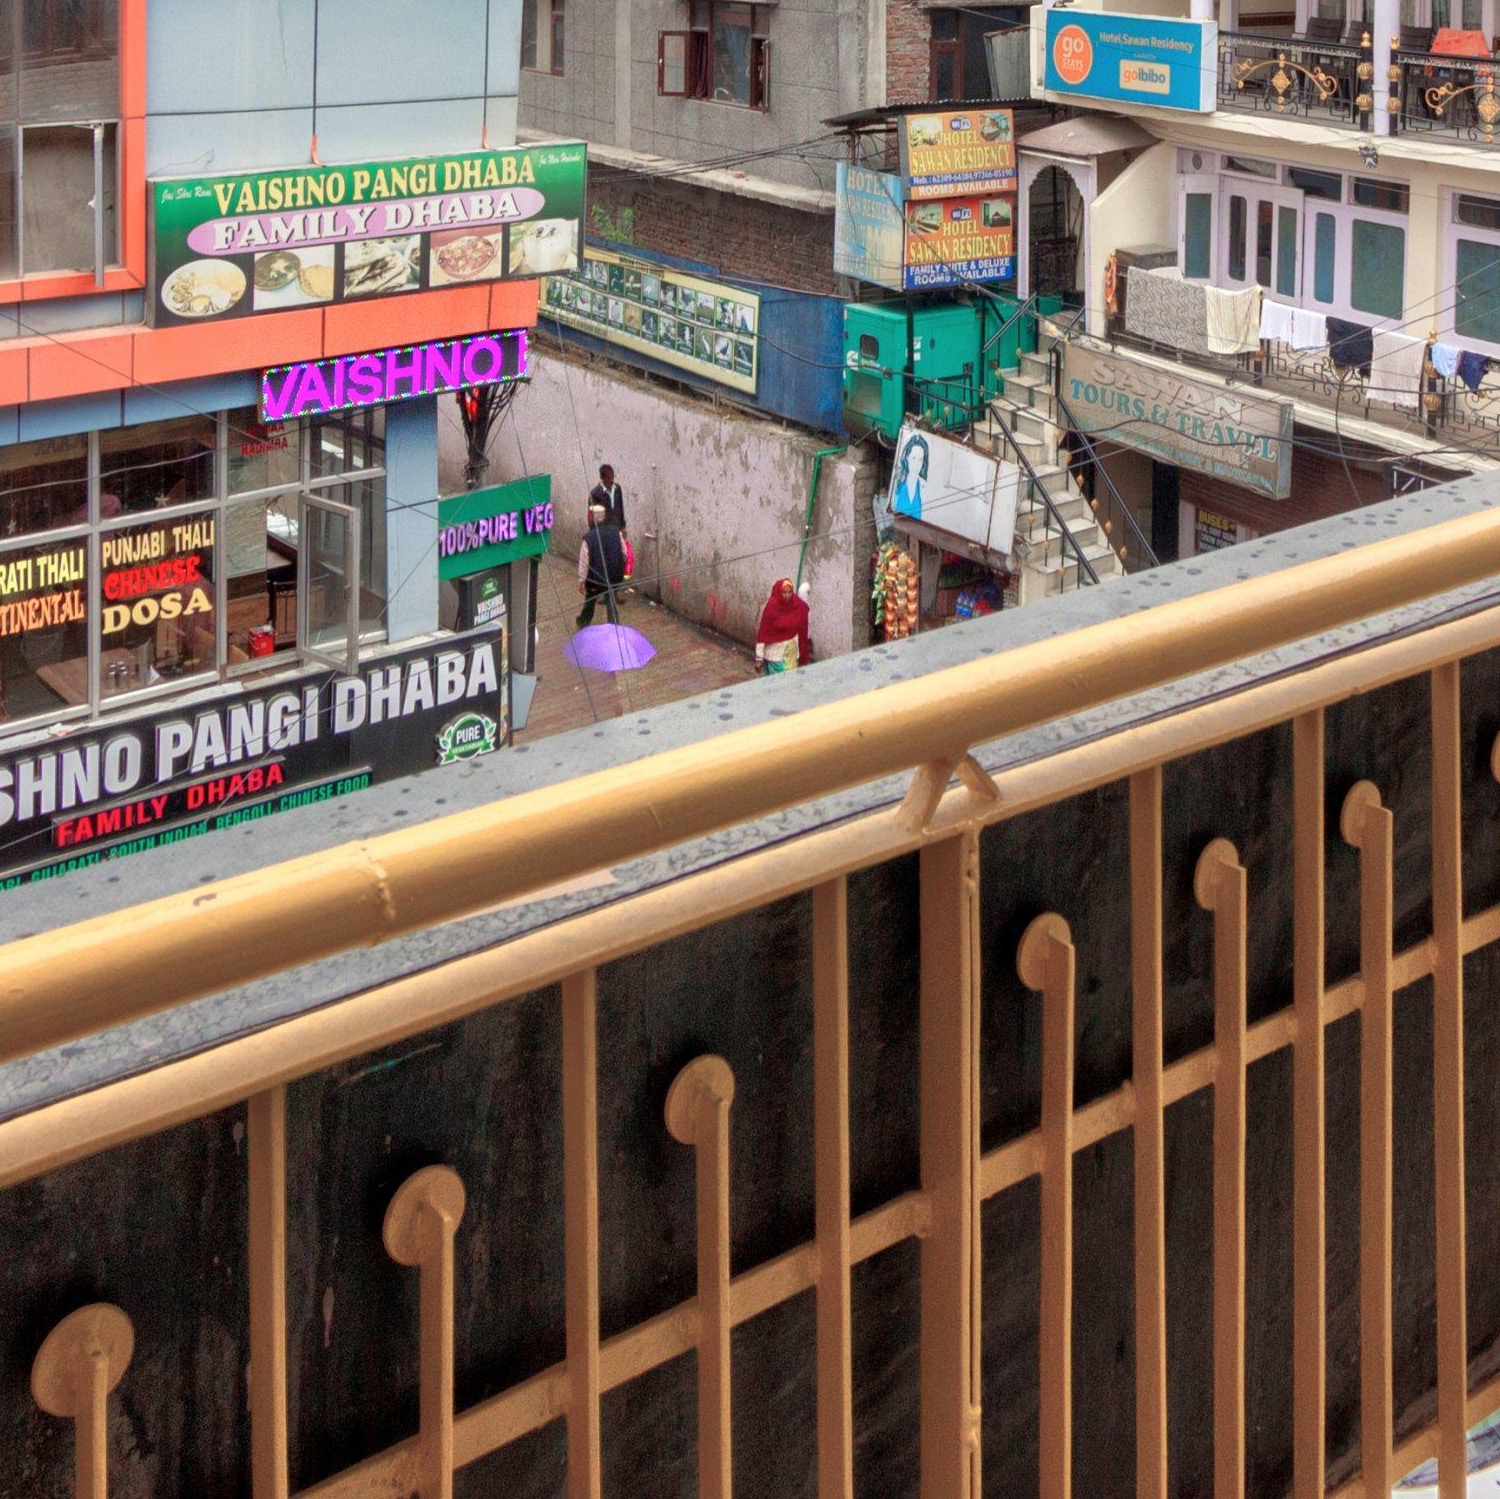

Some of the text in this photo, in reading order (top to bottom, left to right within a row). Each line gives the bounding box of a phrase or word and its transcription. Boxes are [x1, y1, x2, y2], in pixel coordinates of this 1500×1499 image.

[1062, 35, 1084, 57] go
[1099, 31, 1194, 53] Hotel Sawan Residency
[1062, 59, 1084, 72] STAYS
[1123, 68, 1166, 84] goibibo
[942, 130, 980, 146] HOTEL
[912, 144, 1011, 174] SAWAN RESIDENCY
[213, 155, 536, 216] VAISHNO PANGI DHABA
[919, 179, 1008, 196] ROOMS AVAILABLE
[214, 192, 521, 250] FAMILY DHABA
[943, 220, 980, 236] HOTEL
[910, 239, 950, 263] SAWAN
[952, 234, 1011, 260] RESIDENCY
[910, 264, 941, 276] FAMILY
[970, 260, 977, 269] &
[979, 257, 1011, 268] DELUXE
[915, 274, 951, 285] ROOMS
[265, 338, 502, 419] VAISHNO
[1070, 378, 1145, 420] TOURS
[1151, 403, 1169, 426] &
[1176, 409, 1277, 463] TRAVEL
[523, 503, 554, 534] VEG
[102, 520, 215, 568] PUNJABI THALI
[36, 549, 86, 592] THALI
[103, 556, 201, 600] CHINESE
[102, 587, 213, 635] DOSA
[155, 685, 318, 783] PANGI
[332, 643, 498, 734] DHABA
[456, 725, 480, 745] PURE
[56, 762, 284, 847] FAMILY DHABA
[280, 787, 334, 812] CHINESE
[337, 773, 370, 795] FOOD
